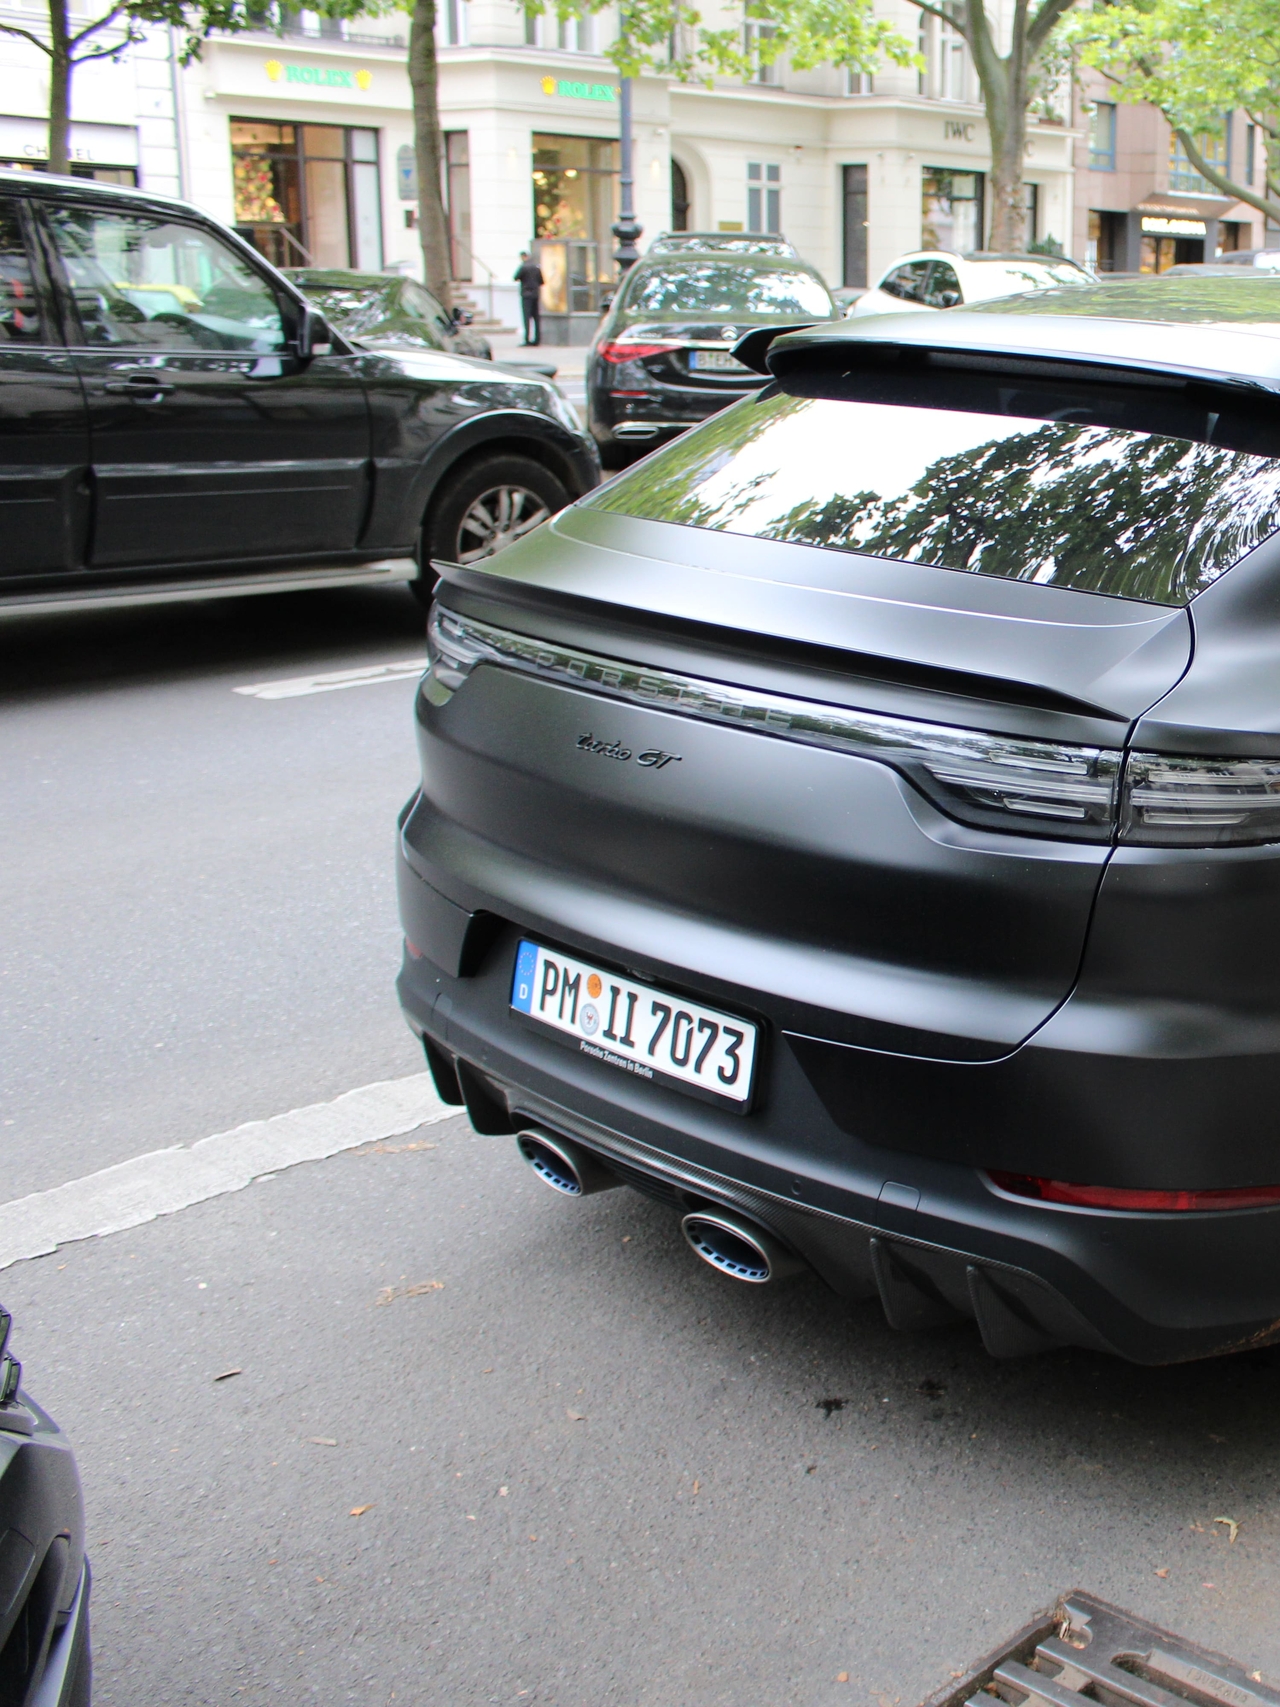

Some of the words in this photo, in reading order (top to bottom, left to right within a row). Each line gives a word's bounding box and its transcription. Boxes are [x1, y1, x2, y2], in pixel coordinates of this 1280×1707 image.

[285, 64, 353, 88] ROLEX
[557, 80, 616, 102] ROLEX
[944, 120, 975, 142] IWC
[23, 144, 95, 161] CHEL
[536, 650, 792, 729] PORSCHE
[576, 732, 632, 761] turbo
[636, 748, 682, 769] GT
[519, 983, 529, 1000] D
[540, 958, 582, 1025] PM
[602, 984, 639, 1049] II
[647, 1000, 745, 1086] 7073
[580, 1040, 604, 1059] Porsche
[626, 1060, 634, 1072] in
